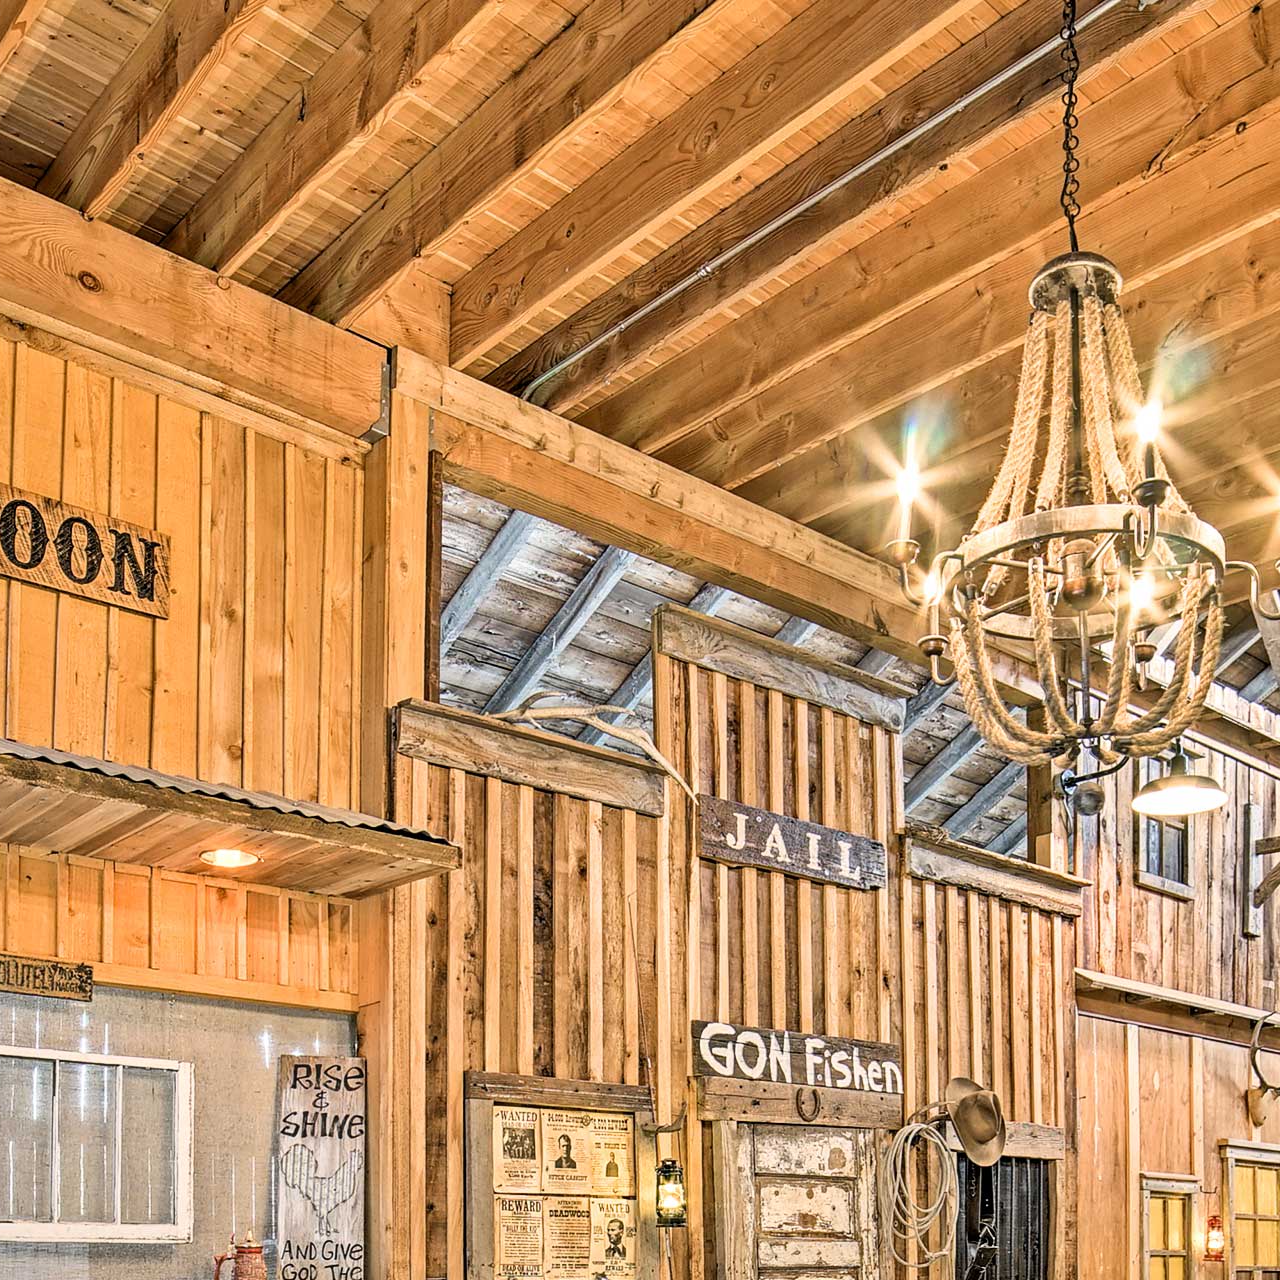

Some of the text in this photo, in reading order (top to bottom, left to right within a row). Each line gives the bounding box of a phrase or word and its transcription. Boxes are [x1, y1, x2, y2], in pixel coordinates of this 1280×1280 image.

[725, 812, 862, 881] JAIL
[699, 1022, 792, 1084] GON
[312, 1090, 329, 1111] &
[500, 1110, 538, 1122] WANTED
[501, 1199, 542, 1212] REWARD
[549, 1209, 591, 1219] DEADWOOD
[598, 1203, 630, 1214] WANTED
[281, 1239, 318, 1261] AND
